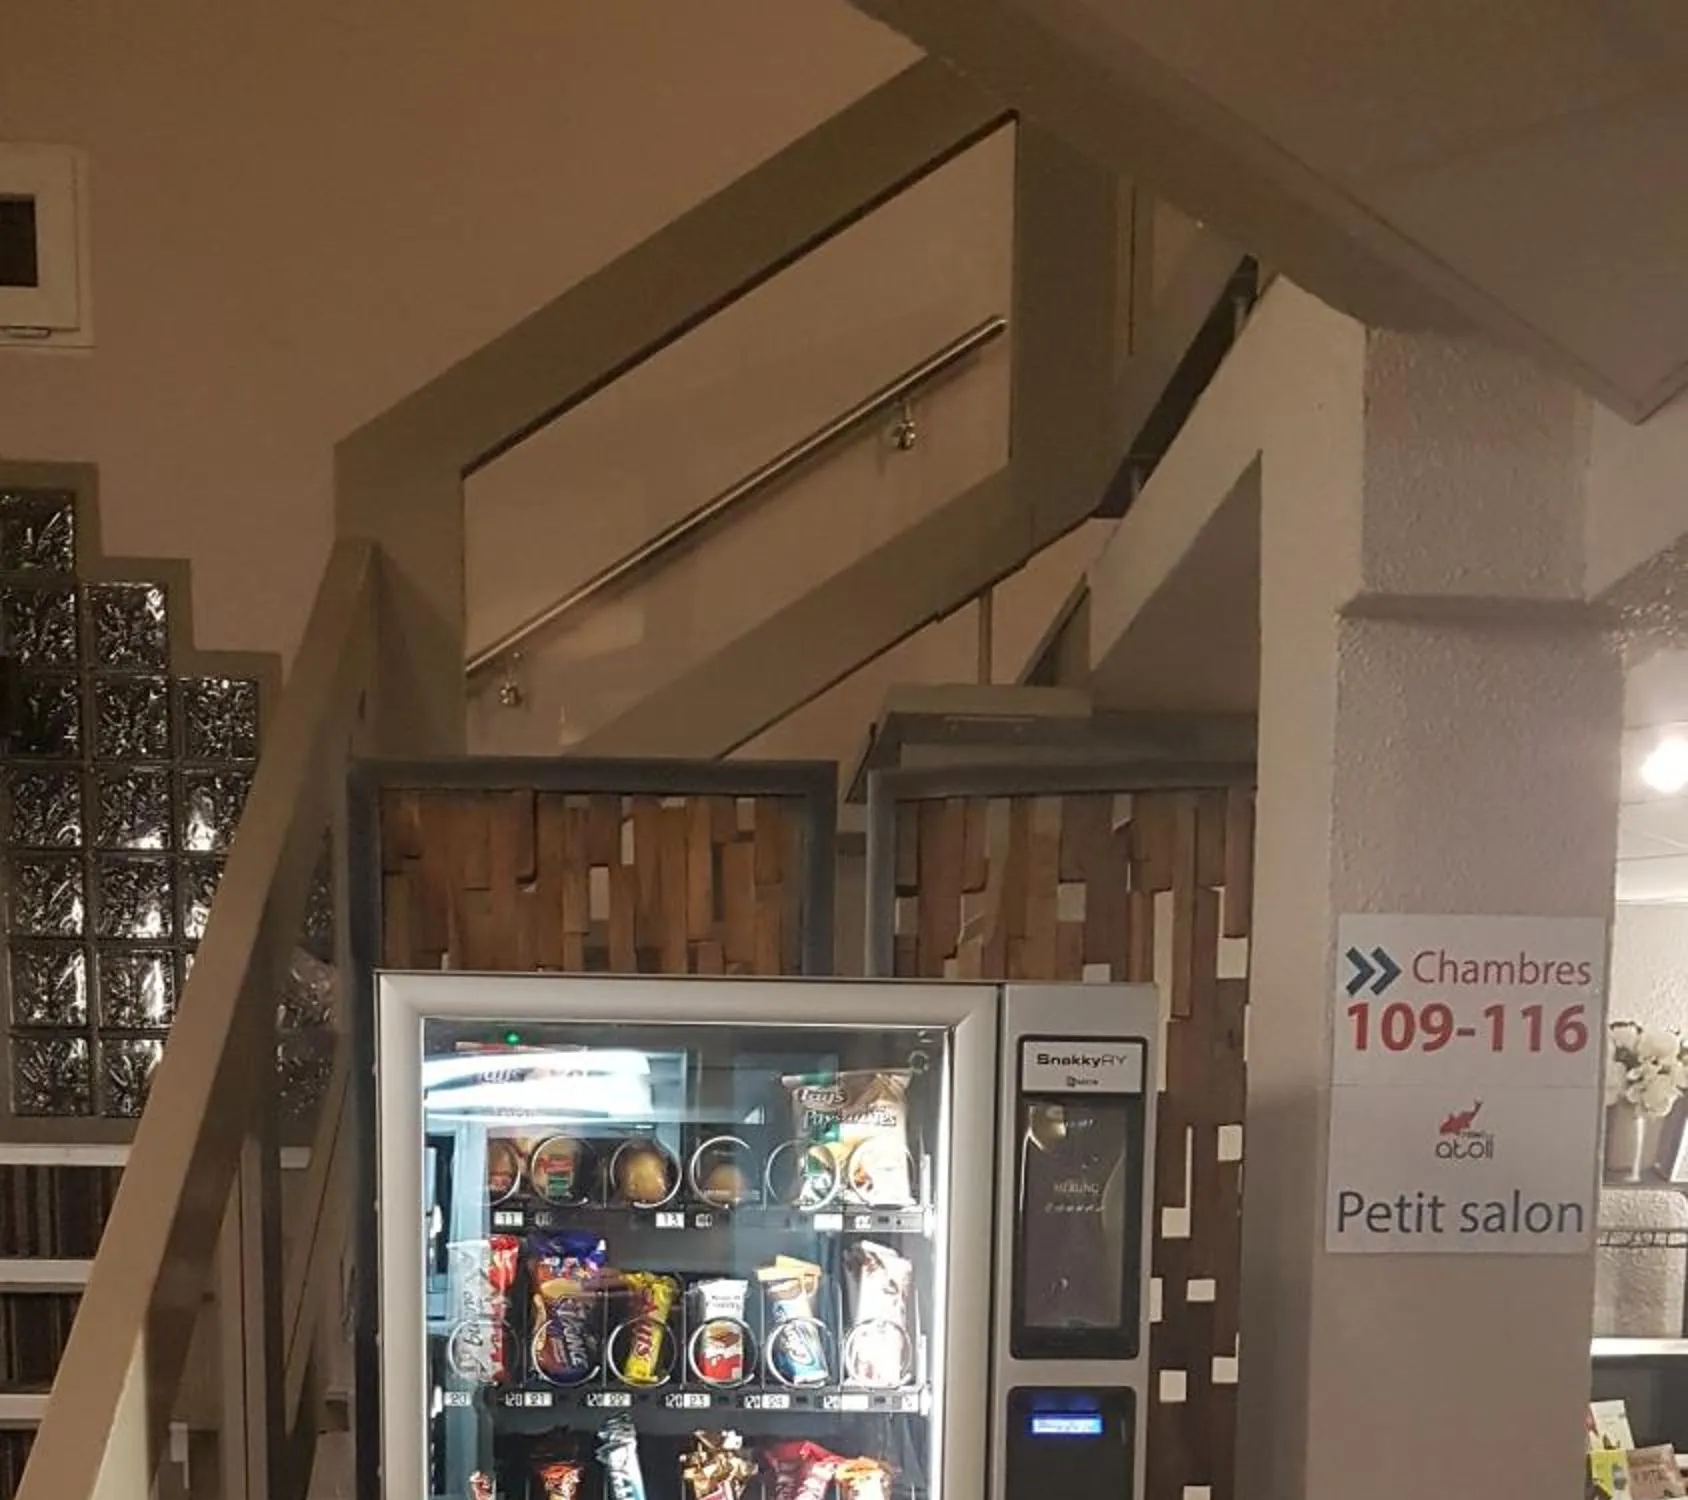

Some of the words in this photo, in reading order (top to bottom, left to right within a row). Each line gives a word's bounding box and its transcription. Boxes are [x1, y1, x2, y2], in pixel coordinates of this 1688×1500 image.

[1412, 947, 1592, 986] Chambres
[1346, 1002, 1589, 1053] 109-116
[1435, 1133, 1495, 1159] atoll
[1337, 1191, 1444, 1234] Petit
[1460, 1189, 1584, 1234] salon
